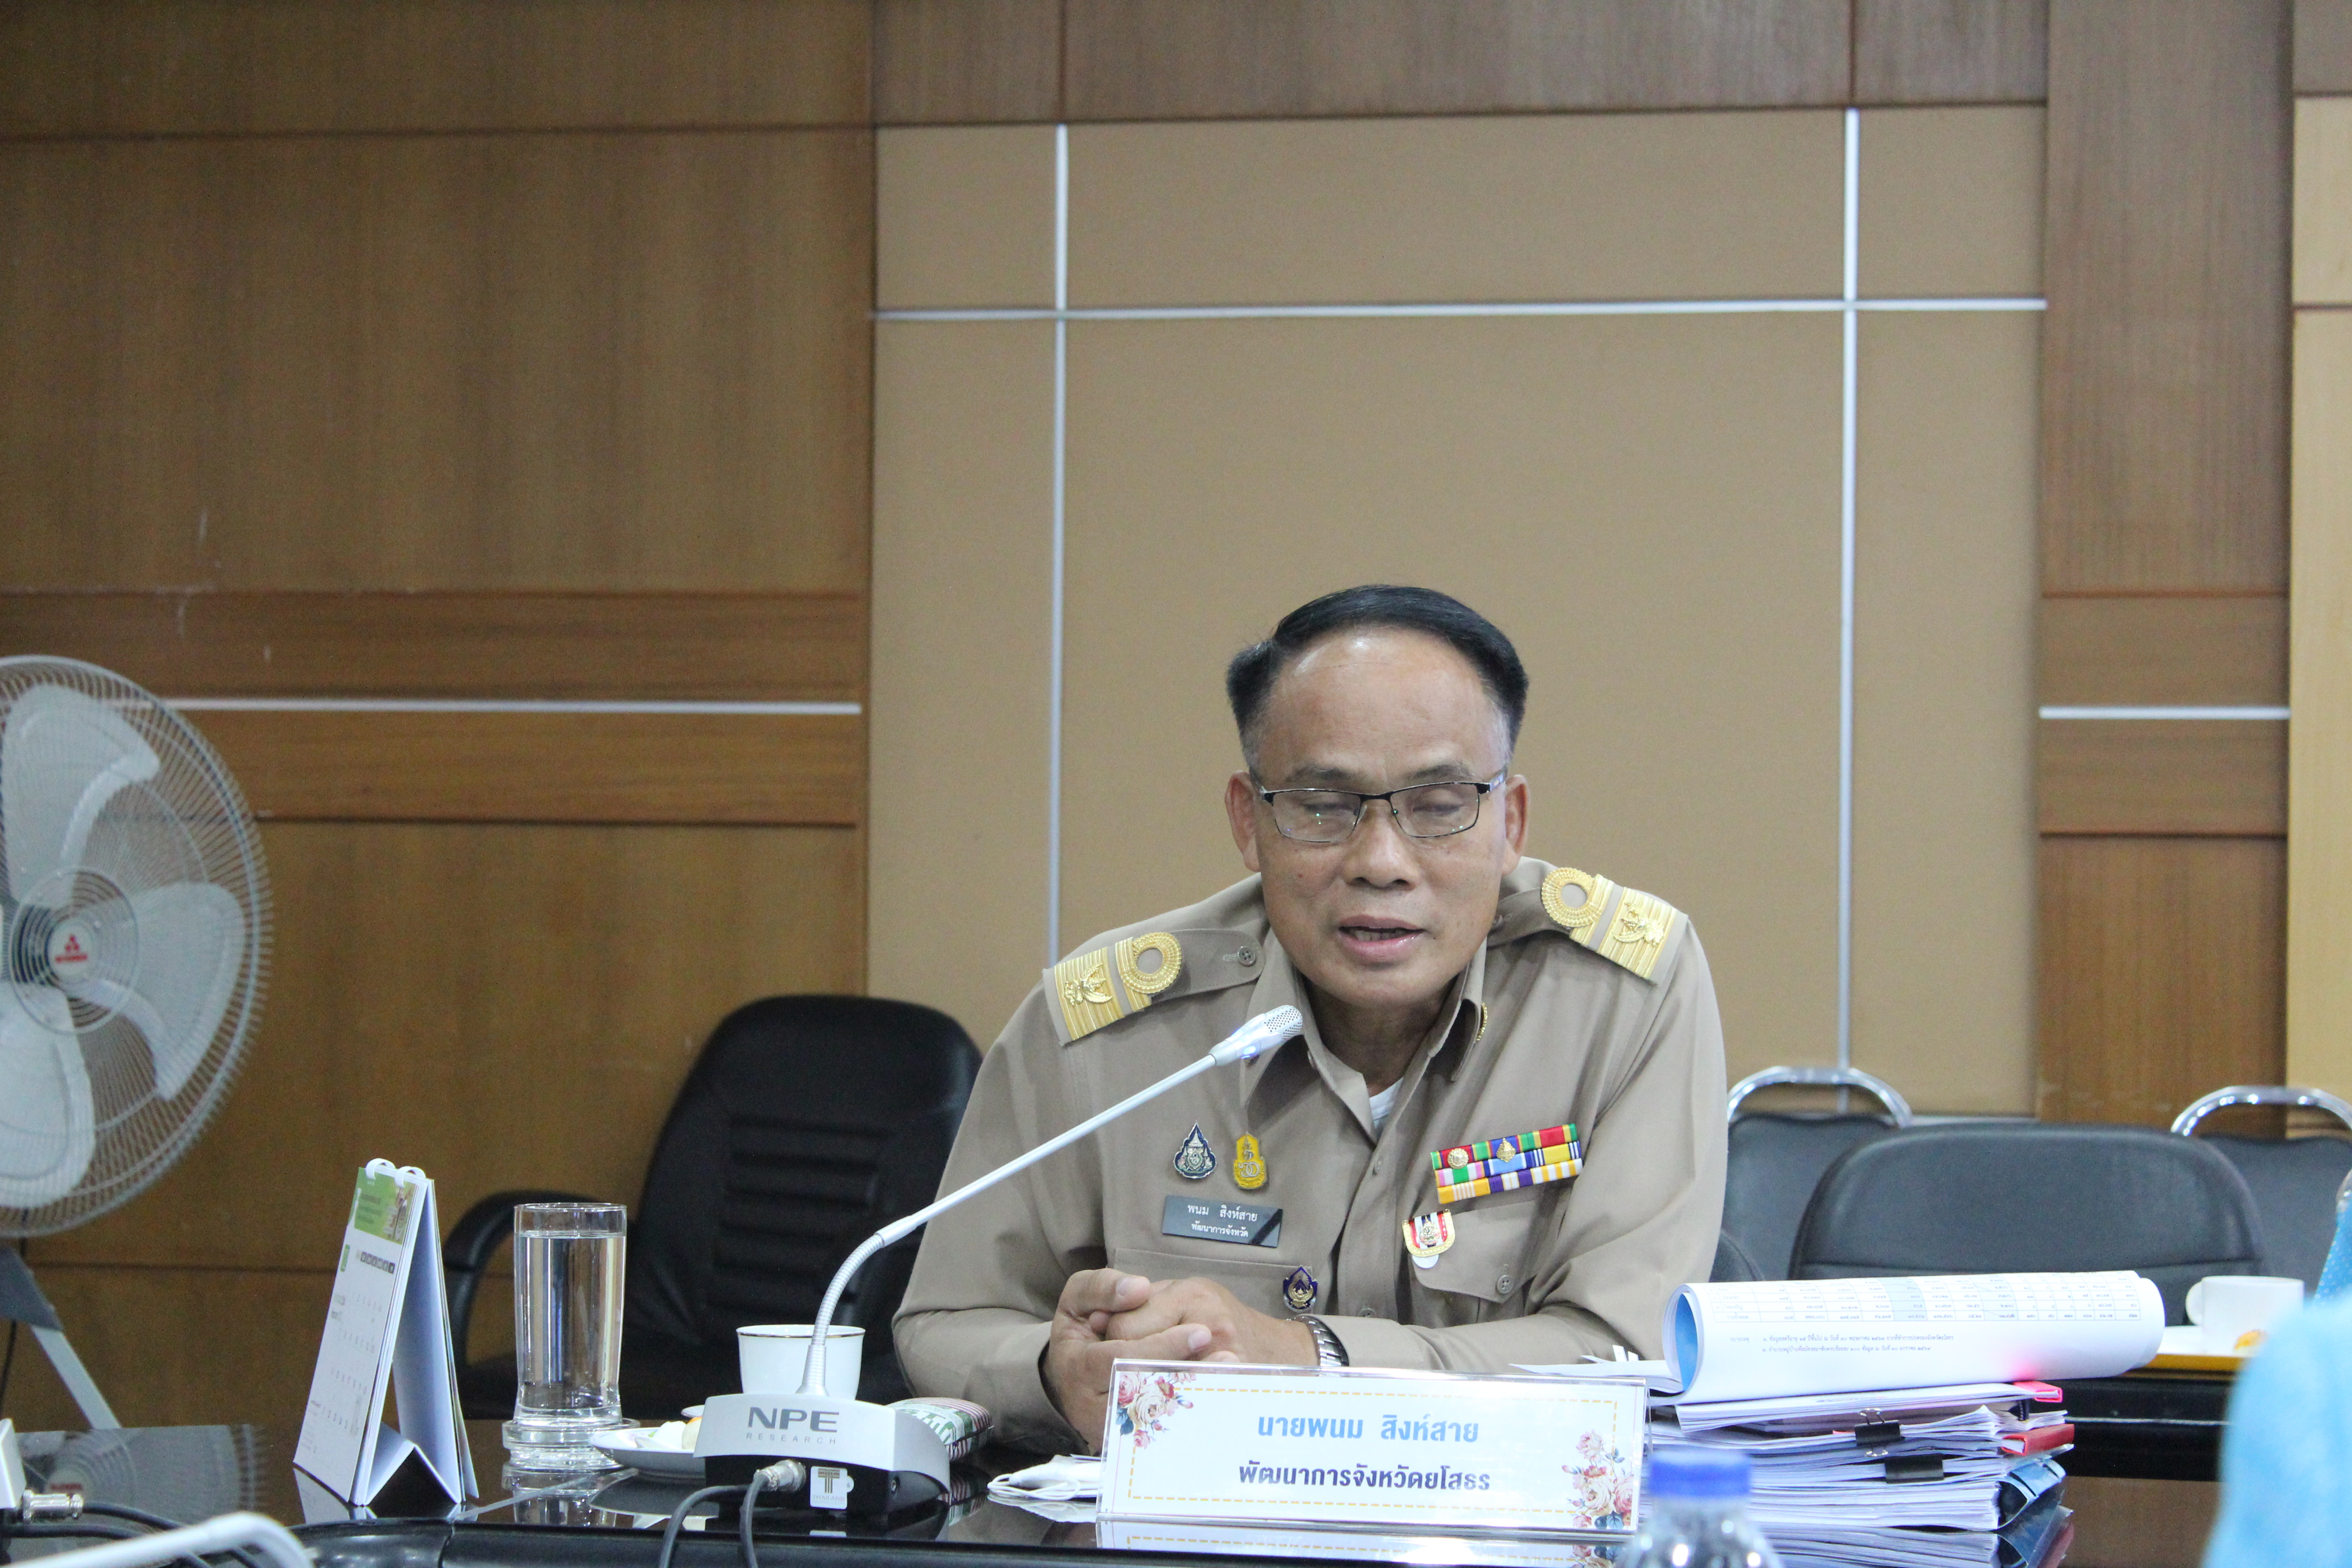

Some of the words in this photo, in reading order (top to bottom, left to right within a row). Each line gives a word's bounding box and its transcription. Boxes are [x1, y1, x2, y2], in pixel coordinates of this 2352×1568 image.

[1187, 1204, 1209, 1215] พนม
[1220, 1204, 1258, 1222] สิงห์สาย
[1191, 1220, 1249, 1237] พัฒนาการจังหวัด
[748, 1406, 840, 1433] NPE
[1258, 1415, 1363, 1441] นายพนม
[1381, 1412, 1479, 1443] สิงห์สาย
[746, 1433, 836, 1445] RESEARCH
[1239, 1460, 1491, 1492] พัฒนาการจังหวัดยโสธร
